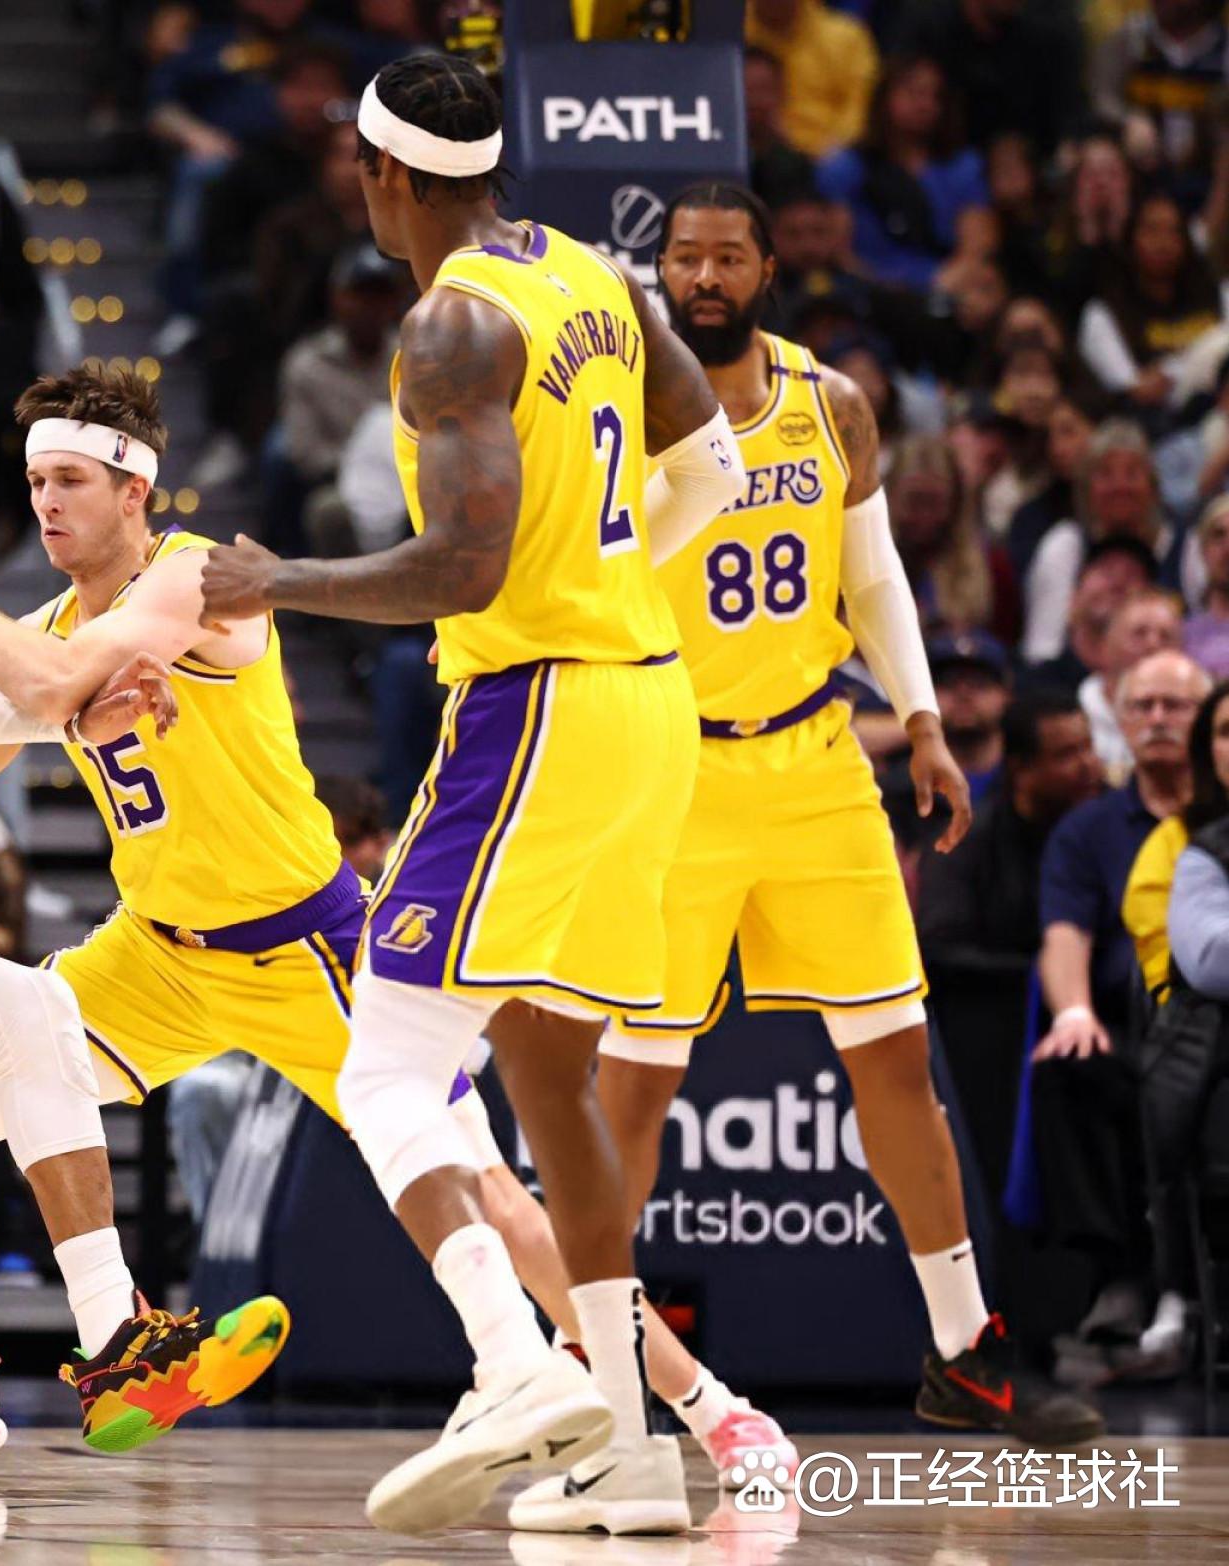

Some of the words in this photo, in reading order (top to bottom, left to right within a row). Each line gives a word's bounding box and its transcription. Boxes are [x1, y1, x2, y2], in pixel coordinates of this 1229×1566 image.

[543, 96, 713, 142] PATH
[537, 309, 640, 405] VANDERBILT
[592, 404, 638, 550] 2
[720, 459, 822, 514] ERS
[706, 533, 808, 625] 88
[82, 730, 167, 832] 15
[636, 1190, 887, 1245] rtsbook
